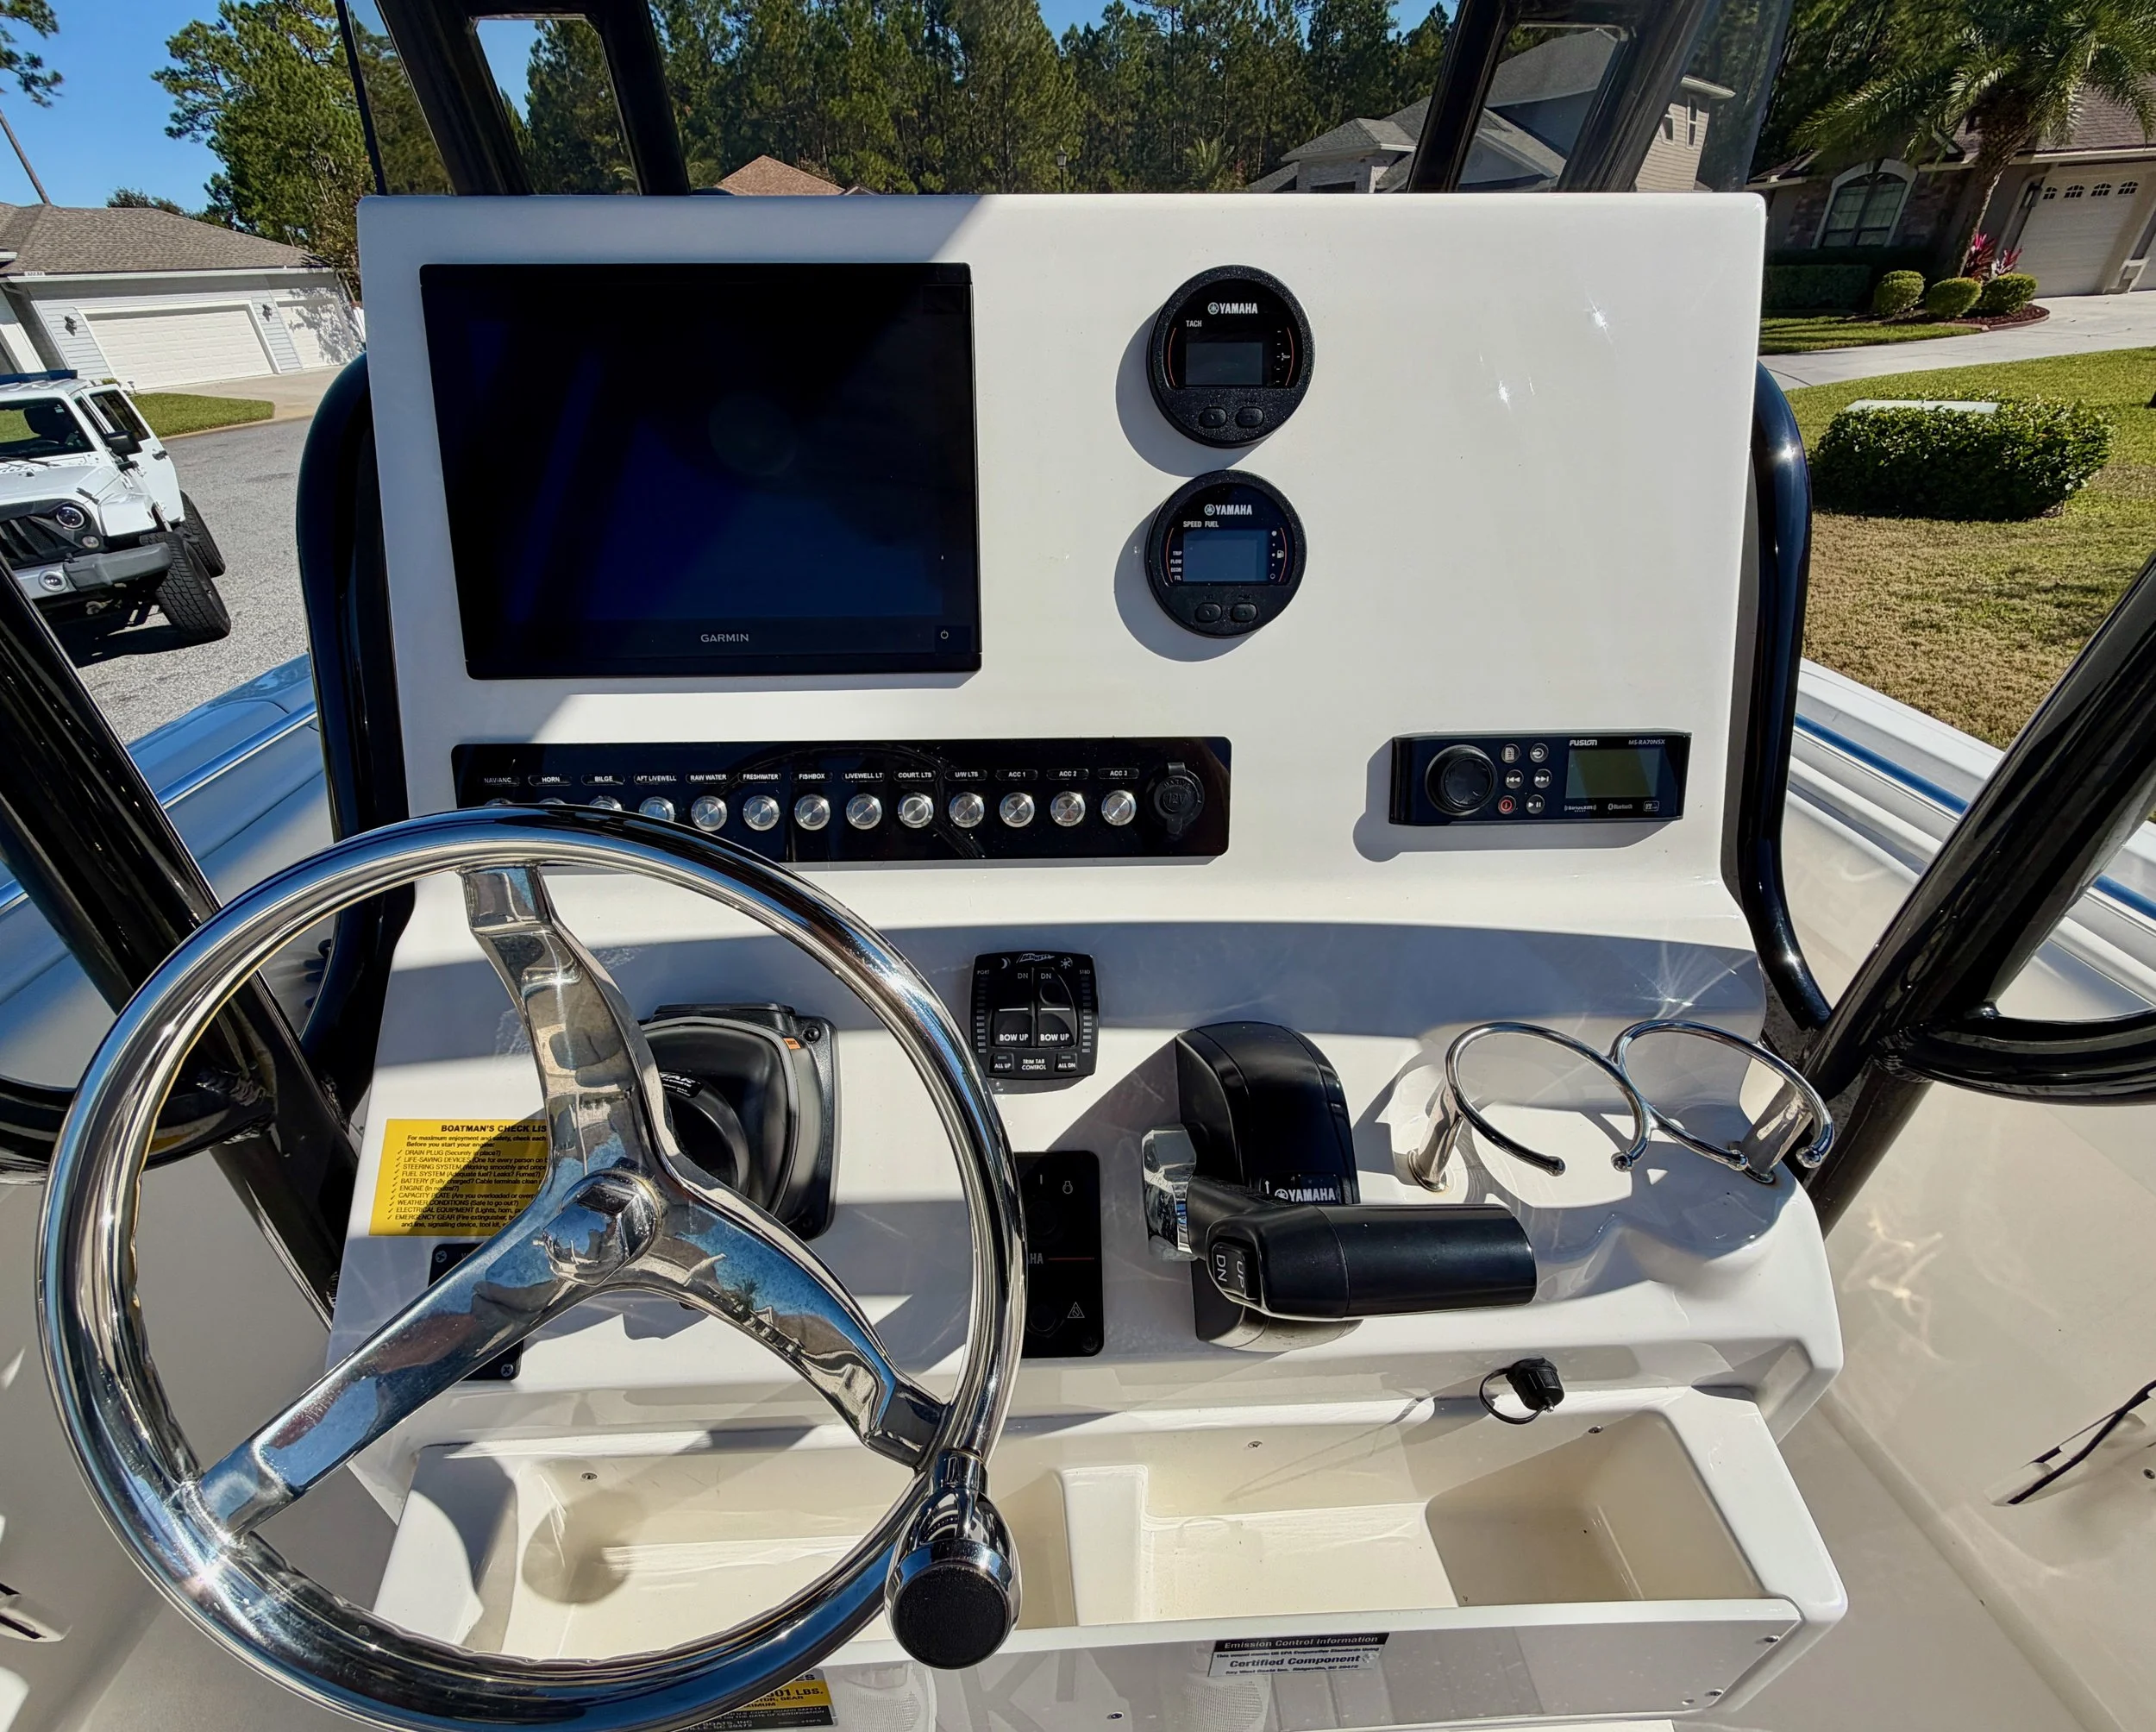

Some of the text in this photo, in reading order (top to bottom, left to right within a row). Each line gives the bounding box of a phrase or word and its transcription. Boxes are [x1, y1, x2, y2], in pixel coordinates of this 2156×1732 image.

[1219, 303, 1258, 314] YAMAHA
[1215, 505, 1252, 515] YAMAHA
[700, 633, 749, 643] GARMIN
[1288, 1188, 1336, 1202] YAMAHA
[1215, 1254, 1228, 1283] DN
[1236, 1260, 1245, 1289] UP
[1225, 1641, 1272, 1649] Emission
[1230, 1655, 1361, 1667] Certified Component
